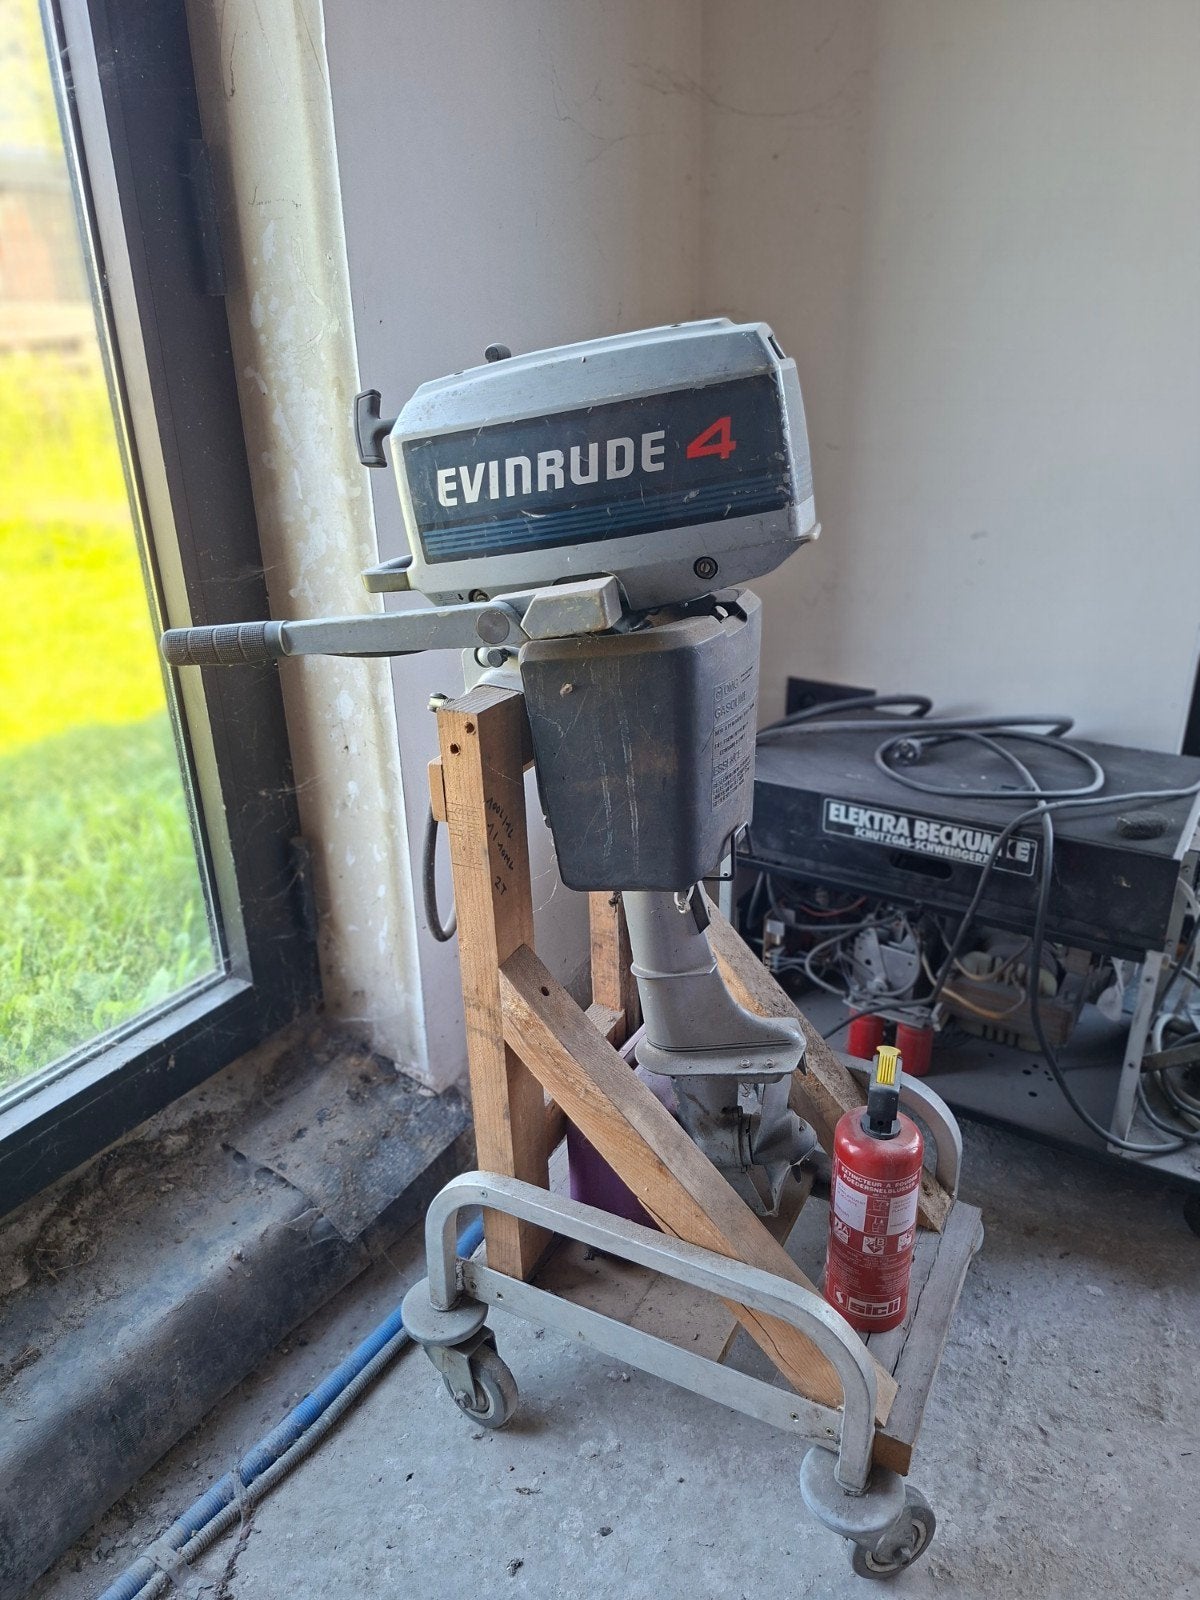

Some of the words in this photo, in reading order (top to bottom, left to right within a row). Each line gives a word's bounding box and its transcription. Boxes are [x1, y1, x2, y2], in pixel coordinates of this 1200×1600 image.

[437, 430, 665, 507] EVINRUDE
[687, 416, 737, 460] 4
[829, 803, 910, 836] ELEKTRA
[841, 1166, 882, 1188] EXTINCTEUR
